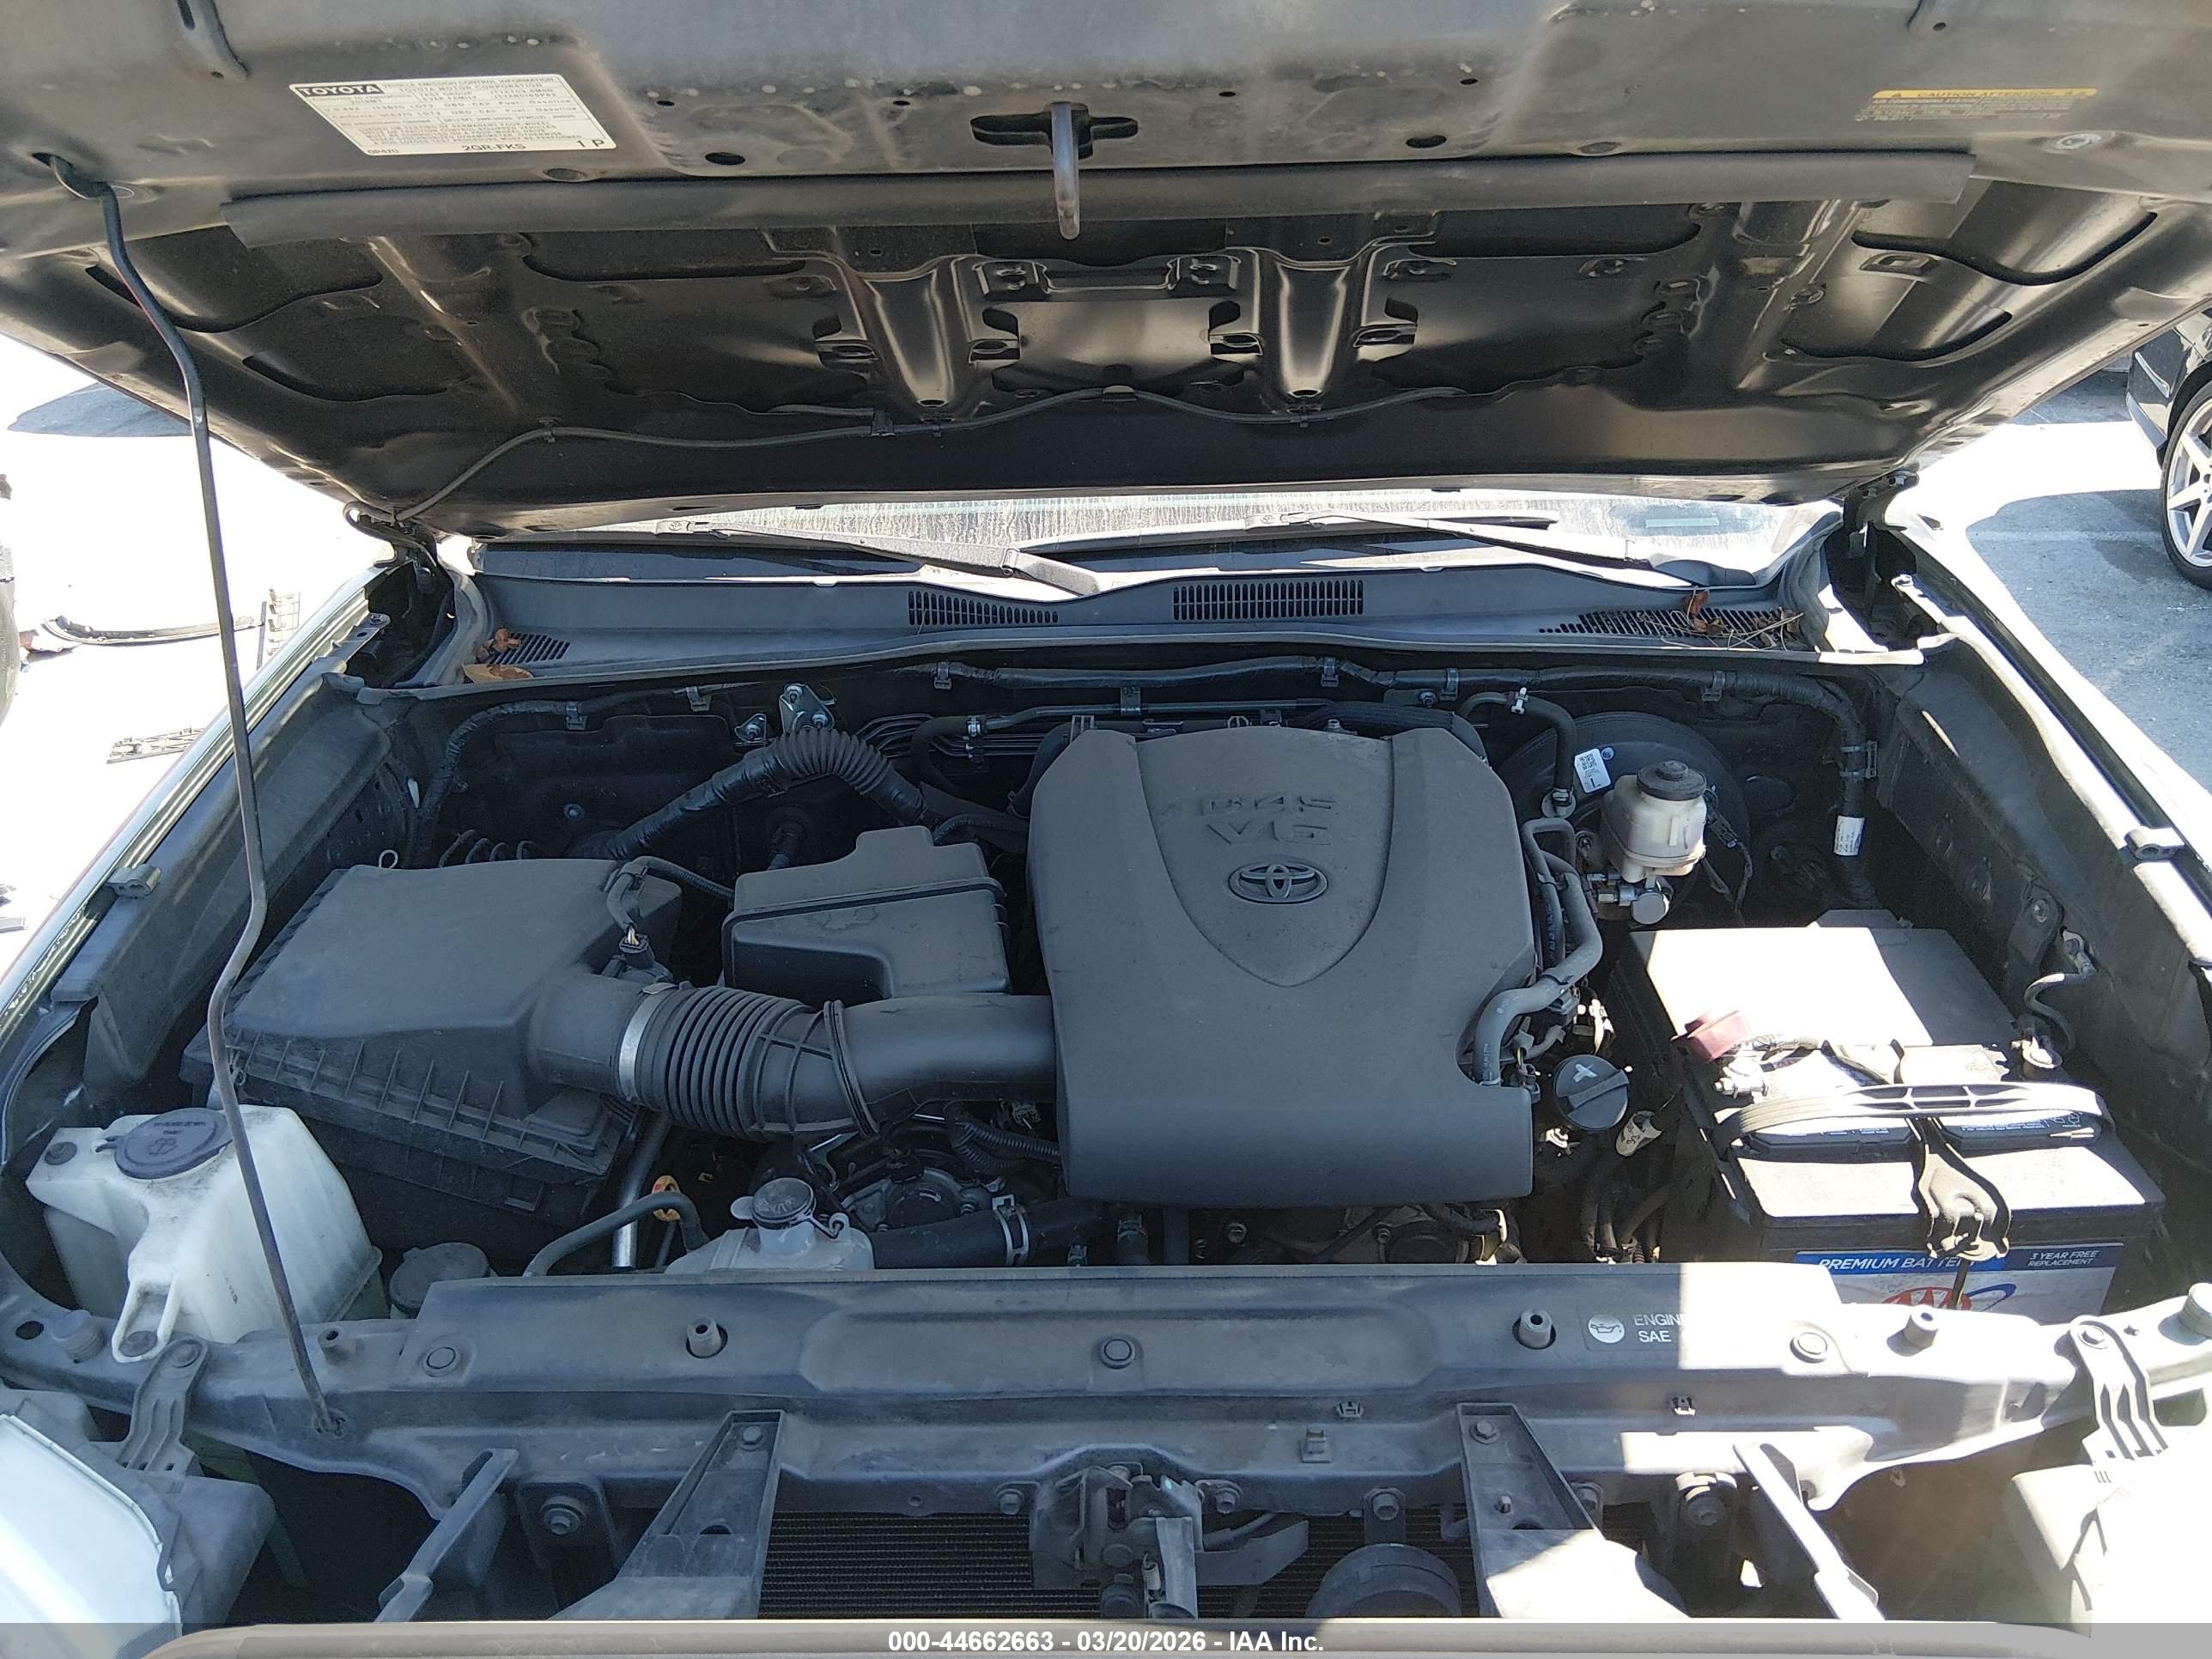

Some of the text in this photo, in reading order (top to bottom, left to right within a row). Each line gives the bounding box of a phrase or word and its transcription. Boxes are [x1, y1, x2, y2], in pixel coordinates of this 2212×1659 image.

[300, 86, 380, 95] TOYOTA
[2039, 1251, 2069, 1260] YEAR
[2069, 1249, 2100, 1259] FREE
[1818, 1257, 1900, 1270] PREMIUM
[2027, 1258, 2094, 1267] REPLACEMENT
[1633, 1313, 1682, 1326] ENGIN
[1638, 1330, 1672, 1343] SAE
